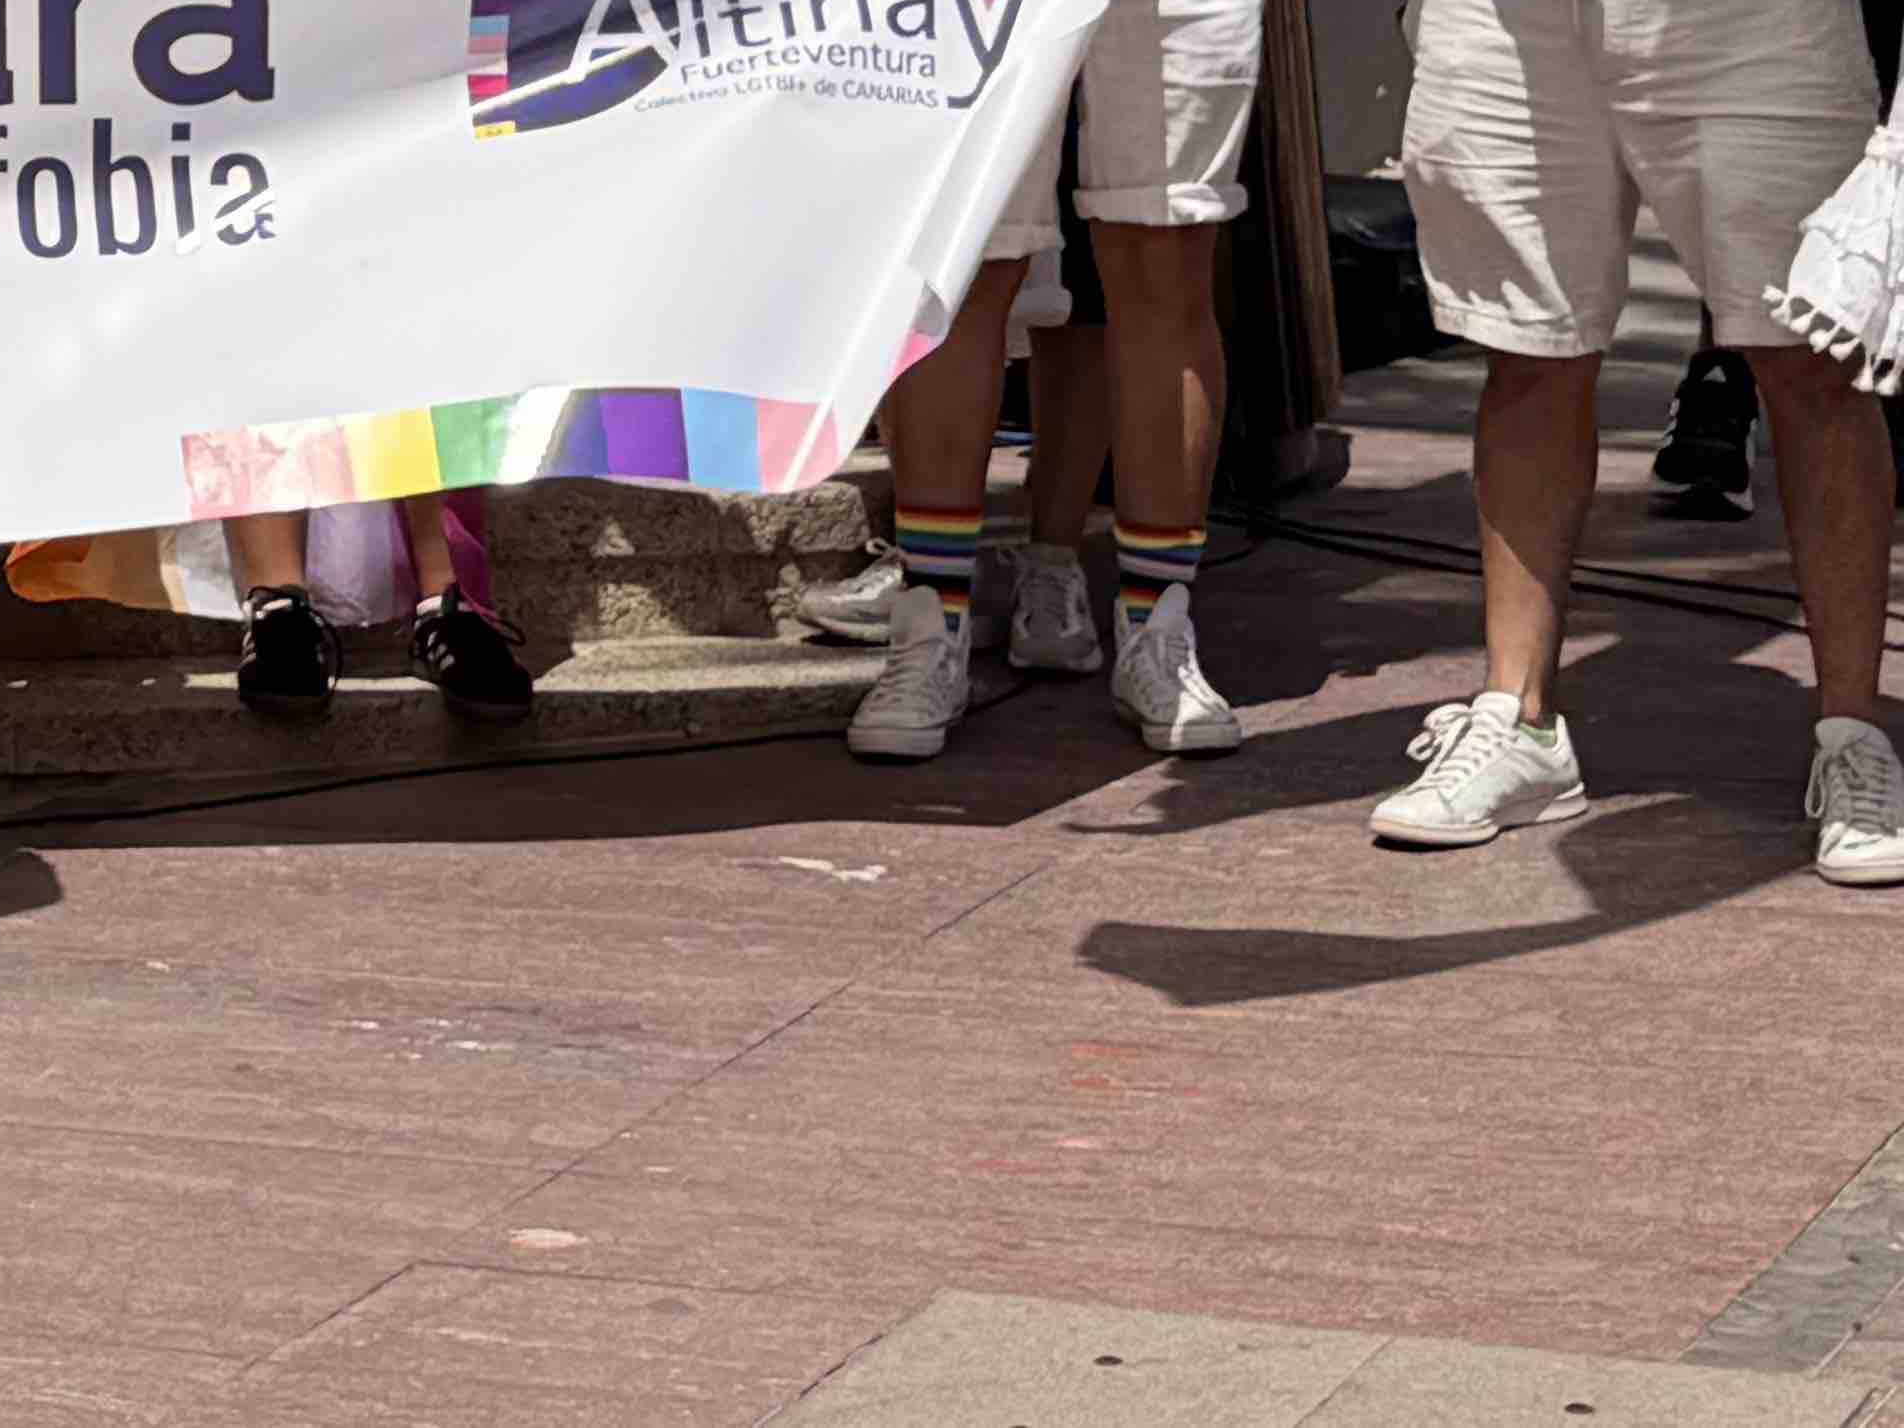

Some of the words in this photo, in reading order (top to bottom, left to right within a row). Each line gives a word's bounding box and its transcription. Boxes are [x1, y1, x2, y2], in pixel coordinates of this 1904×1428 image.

[680, 42, 937, 85] Fuerteventura
[813, 78, 837, 98] de
[842, 79, 939, 110] CANARIAS
